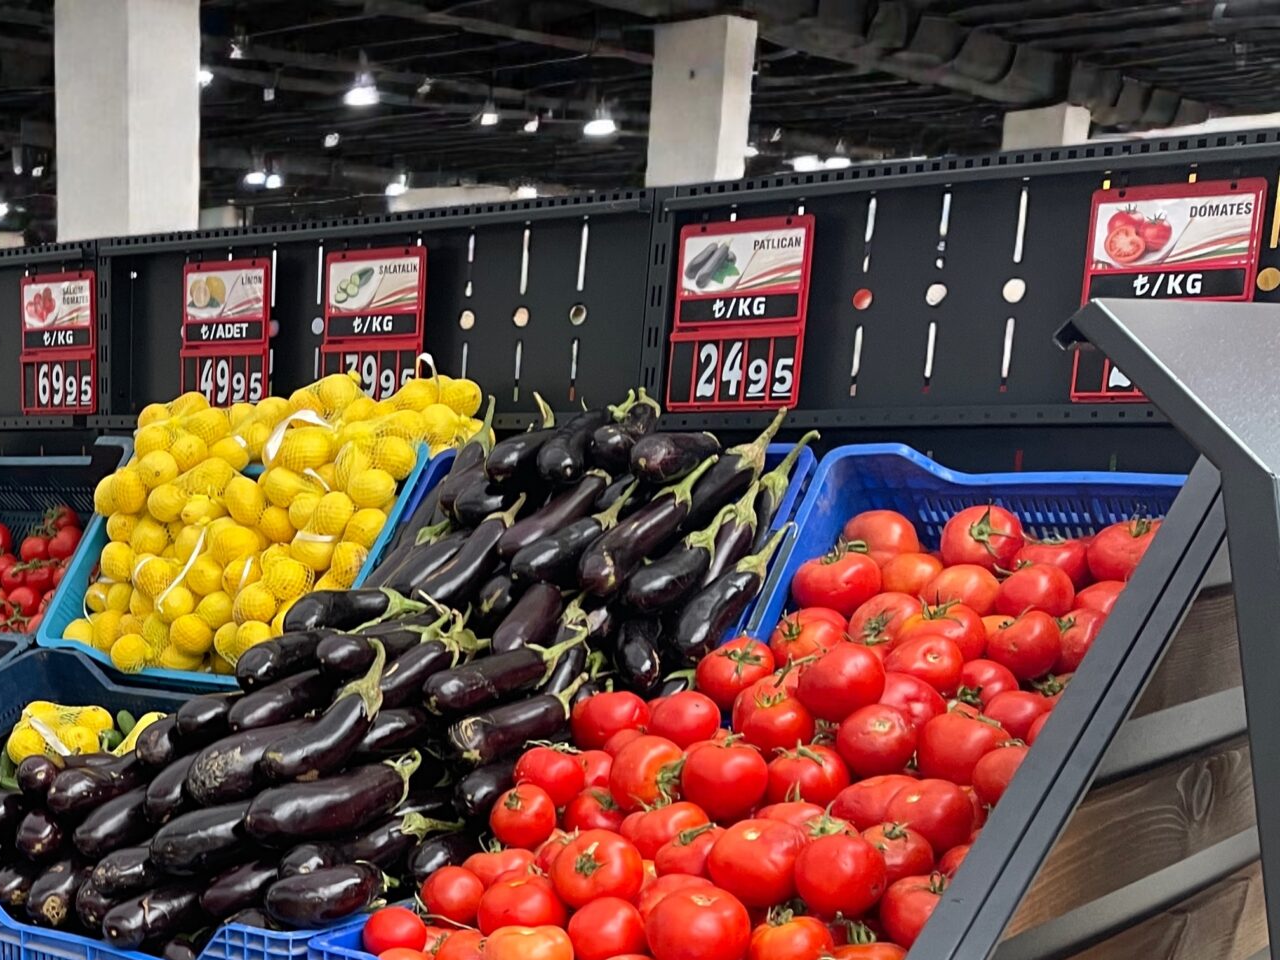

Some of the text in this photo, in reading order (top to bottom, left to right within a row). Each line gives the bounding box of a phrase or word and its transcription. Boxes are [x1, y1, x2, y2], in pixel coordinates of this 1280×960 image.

[1189, 202, 1252, 218] DOMATES
[753, 236, 802, 250] PATLICAN
[1133, 273, 1203, 297] ₺/KG
[712, 297, 766, 319] ₺/KG
[200, 323, 249, 340] ₺/ADET
[352, 315, 393, 333] ₺/KG
